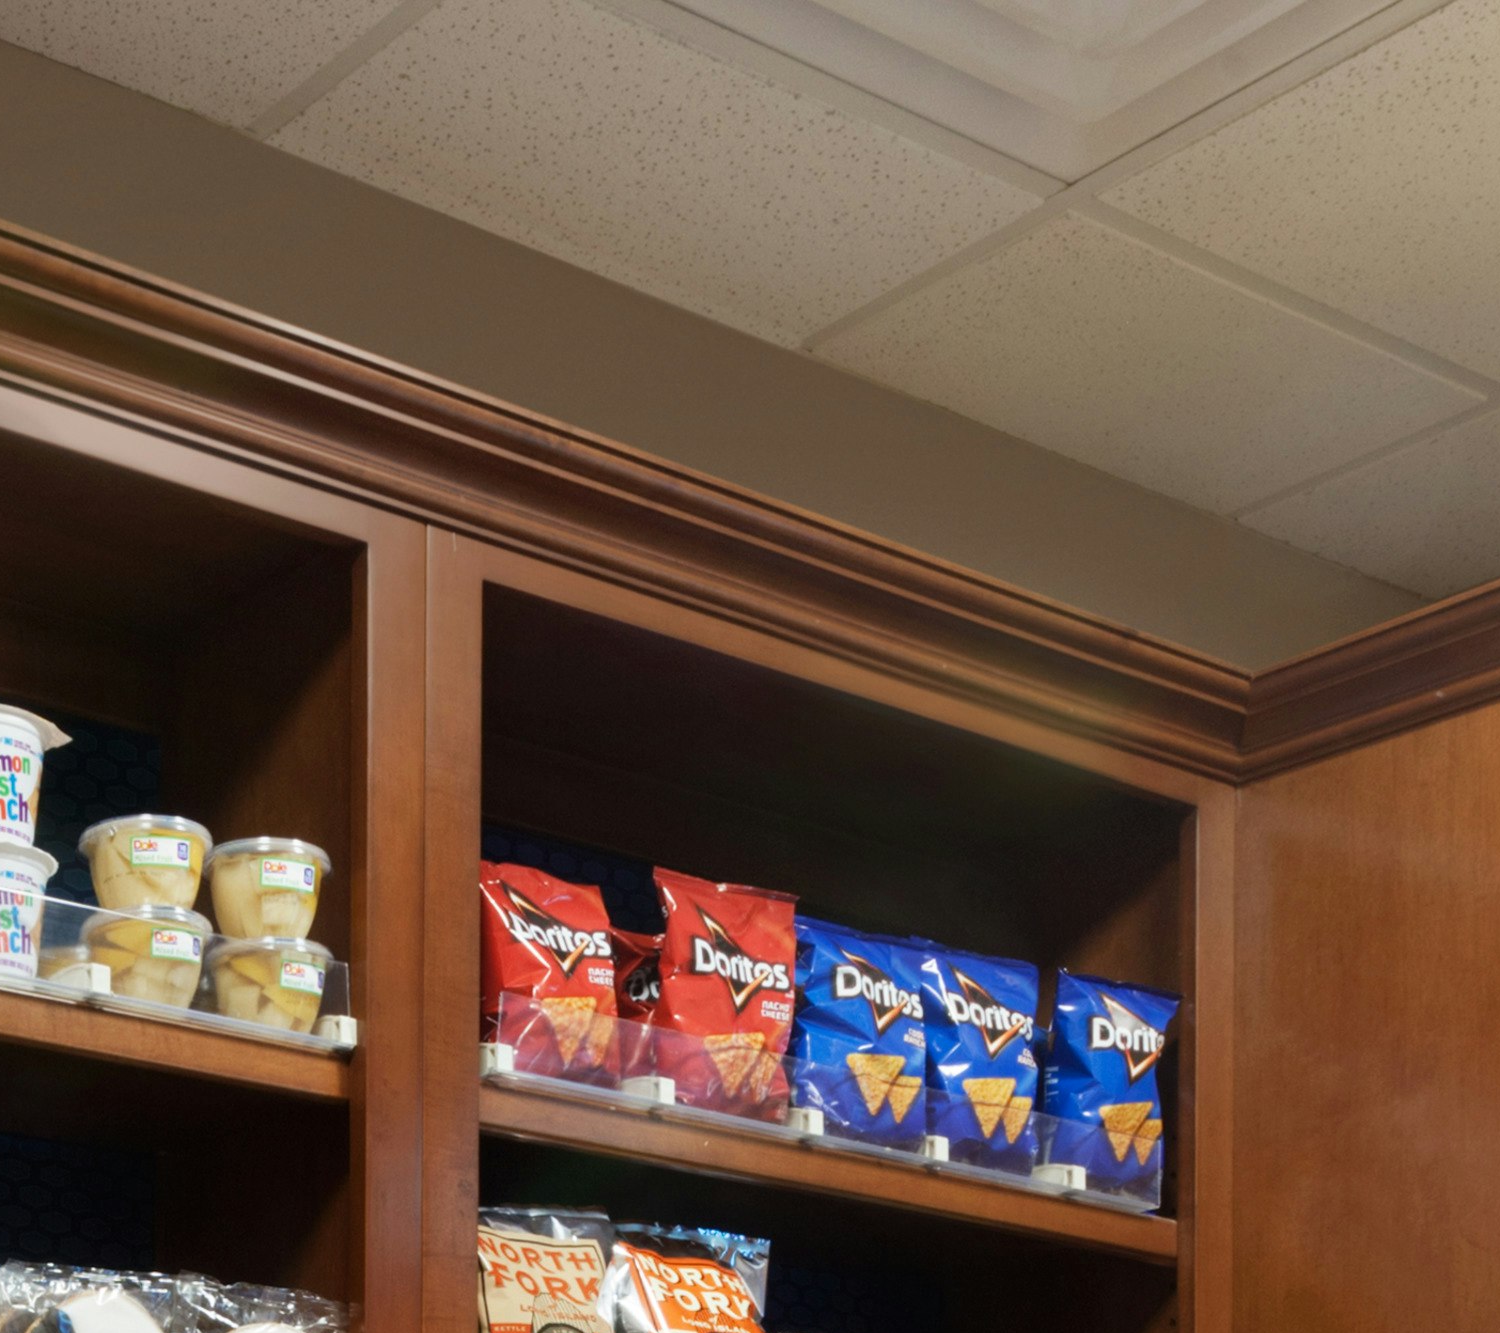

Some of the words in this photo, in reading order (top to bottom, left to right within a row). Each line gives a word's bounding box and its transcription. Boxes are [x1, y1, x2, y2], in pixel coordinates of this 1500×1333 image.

[510, 908, 612, 957] Doritos
[694, 938, 790, 990] Doritos
[835, 964, 924, 1019] Doritos
[478, 1234, 598, 1273] NORTH
[640, 1255, 745, 1293] NORTH
[650, 1276, 751, 1320] FORK
